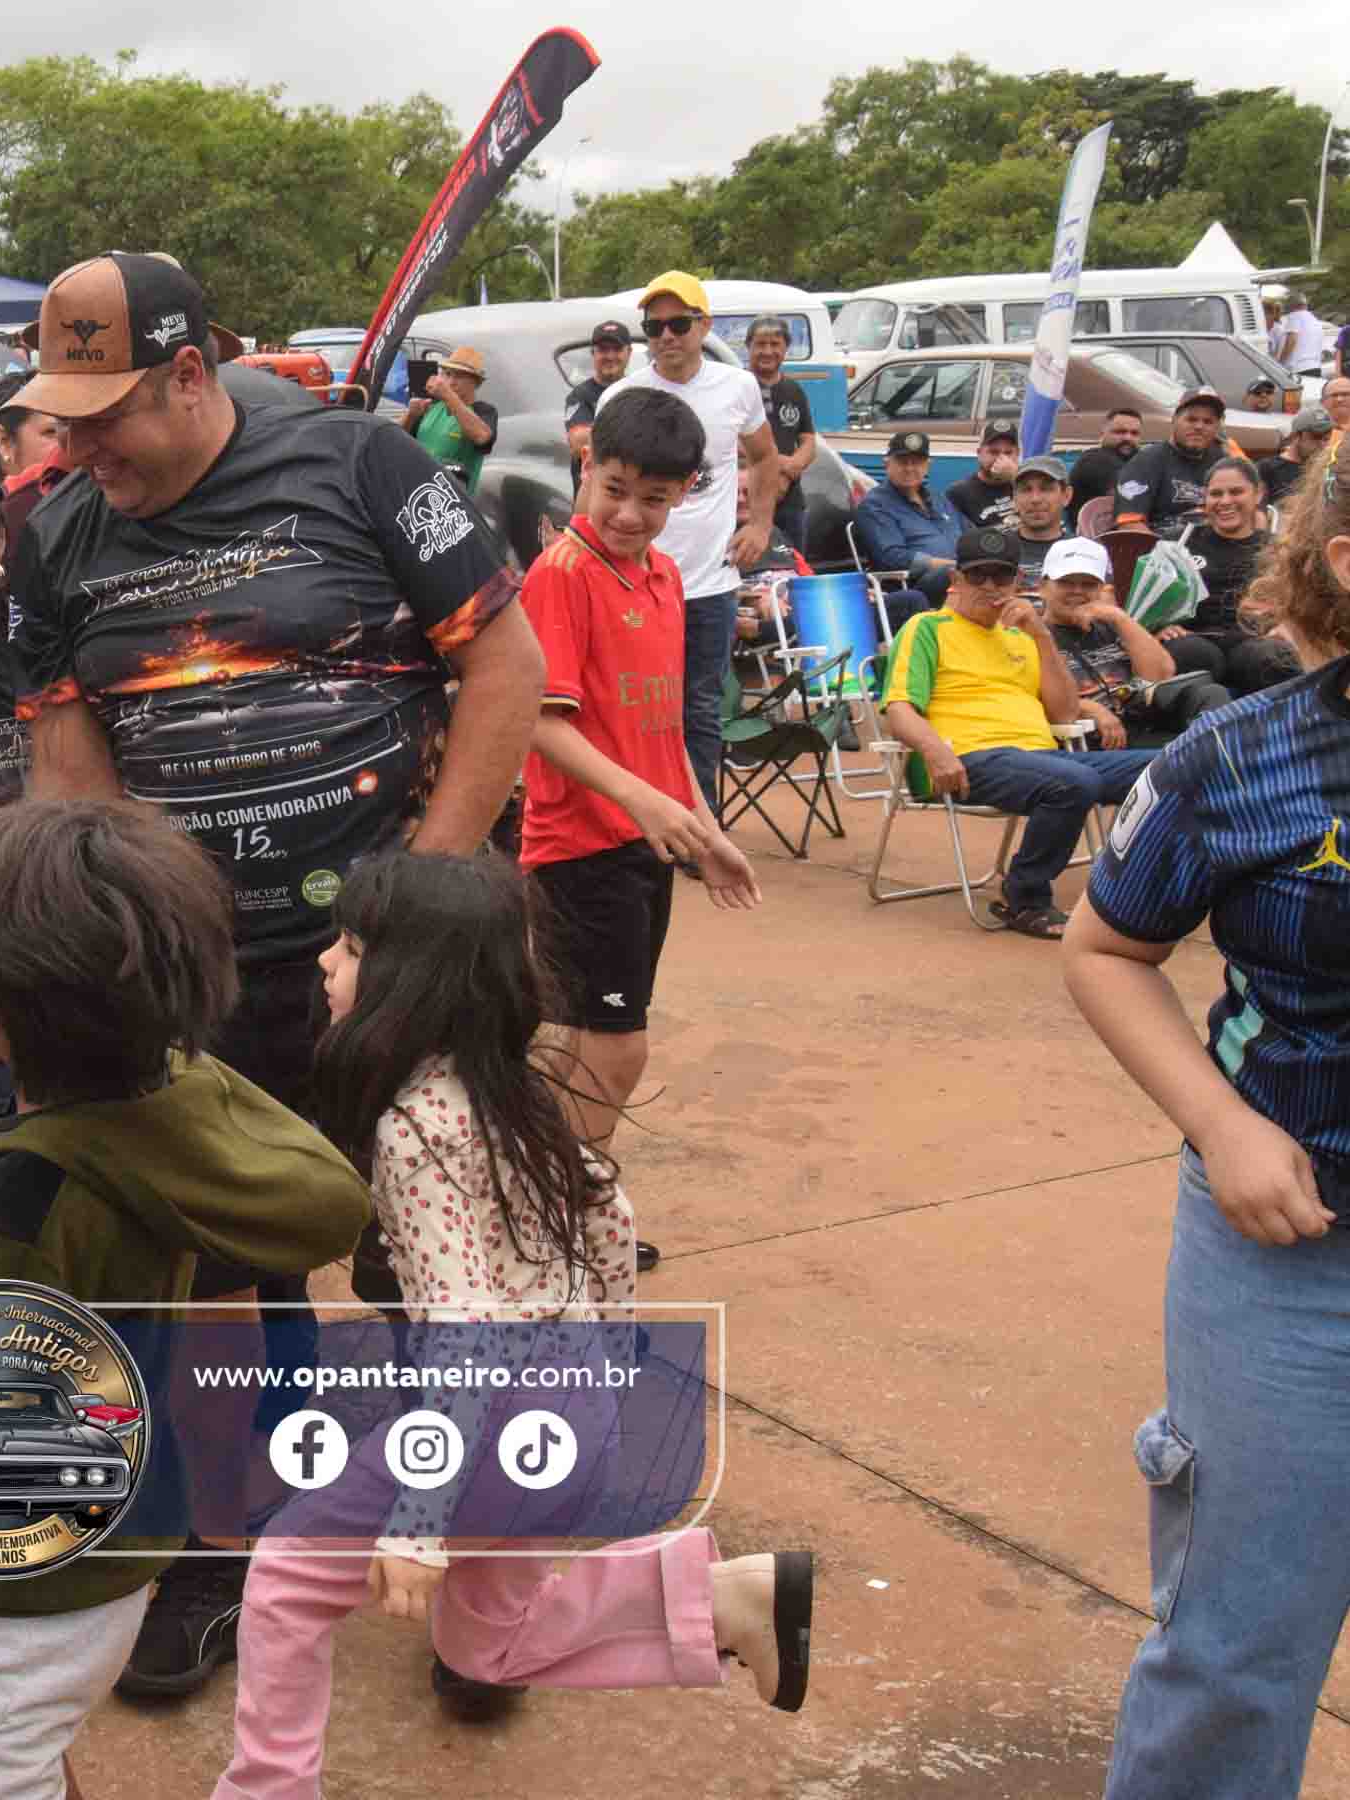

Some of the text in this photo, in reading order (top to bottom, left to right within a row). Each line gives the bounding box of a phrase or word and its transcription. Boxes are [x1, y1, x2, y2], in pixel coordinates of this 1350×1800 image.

[161, 312, 186, 328] MEVO
[169, 785, 354, 834] DIÇÃO COMEMORATIVA
[232, 825, 273, 861] 15
